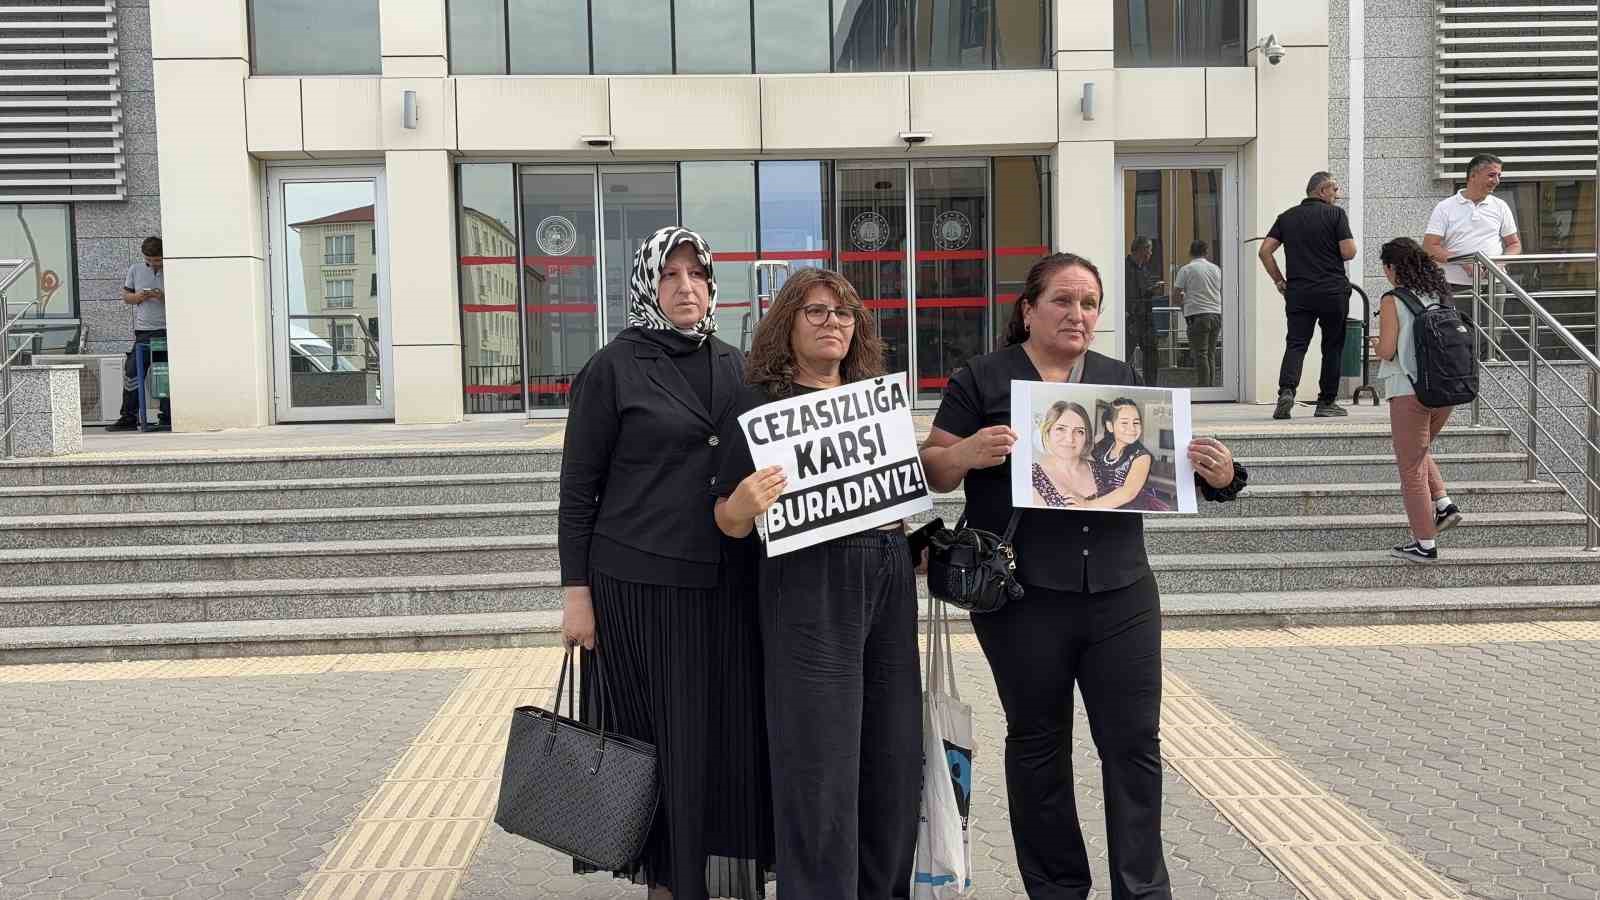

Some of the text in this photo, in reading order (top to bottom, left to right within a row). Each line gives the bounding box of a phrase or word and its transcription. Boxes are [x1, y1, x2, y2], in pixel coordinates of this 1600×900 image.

[748, 377, 906, 446] CEZASIZLIĞA
[793, 422, 887, 480] KARŞI
[766, 462, 924, 534] BURADAYIZ!
